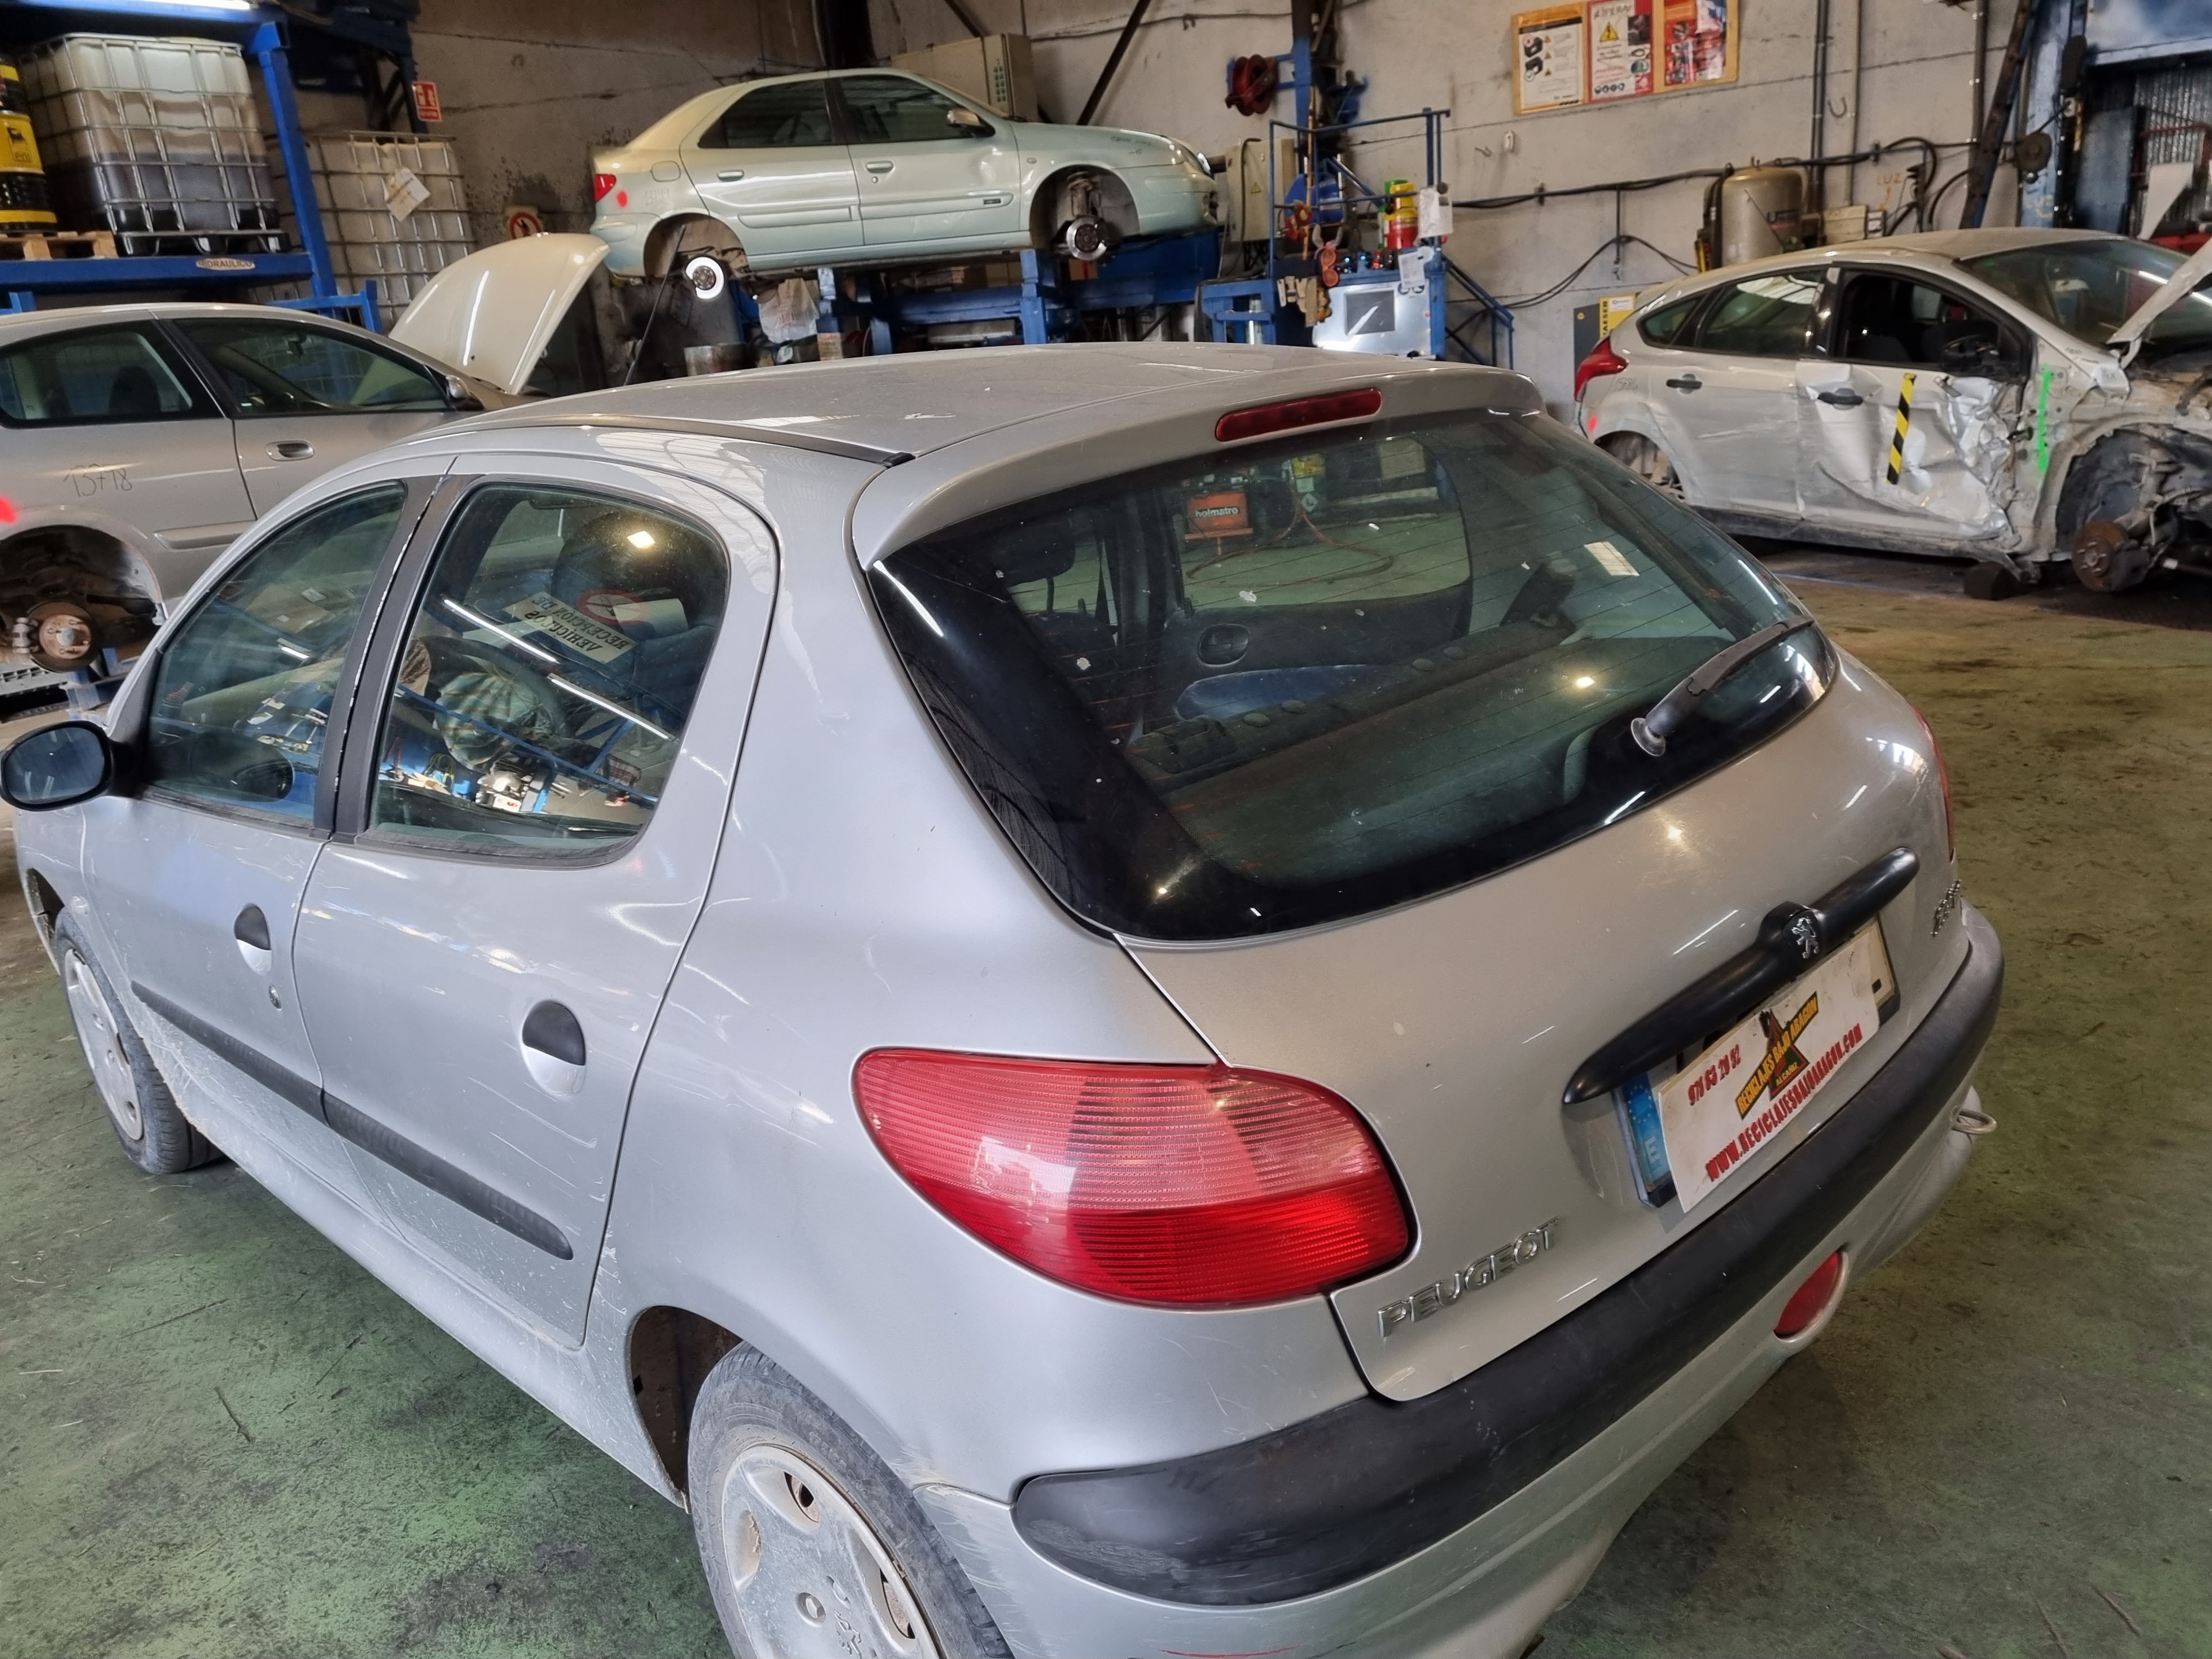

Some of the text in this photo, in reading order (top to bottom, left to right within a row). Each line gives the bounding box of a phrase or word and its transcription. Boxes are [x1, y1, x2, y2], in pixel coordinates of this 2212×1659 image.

[1195, 507, 1239, 517] holmatro
[1705, 1022, 1863, 1183] WWW.RECICLAJESBAJOARAGON.COM
[1737, 1053, 1775, 1115] RECICLAJES
[1772, 1031, 1791, 1062] BAJO
[1377, 1216, 1559, 1338] PEUGEOT
